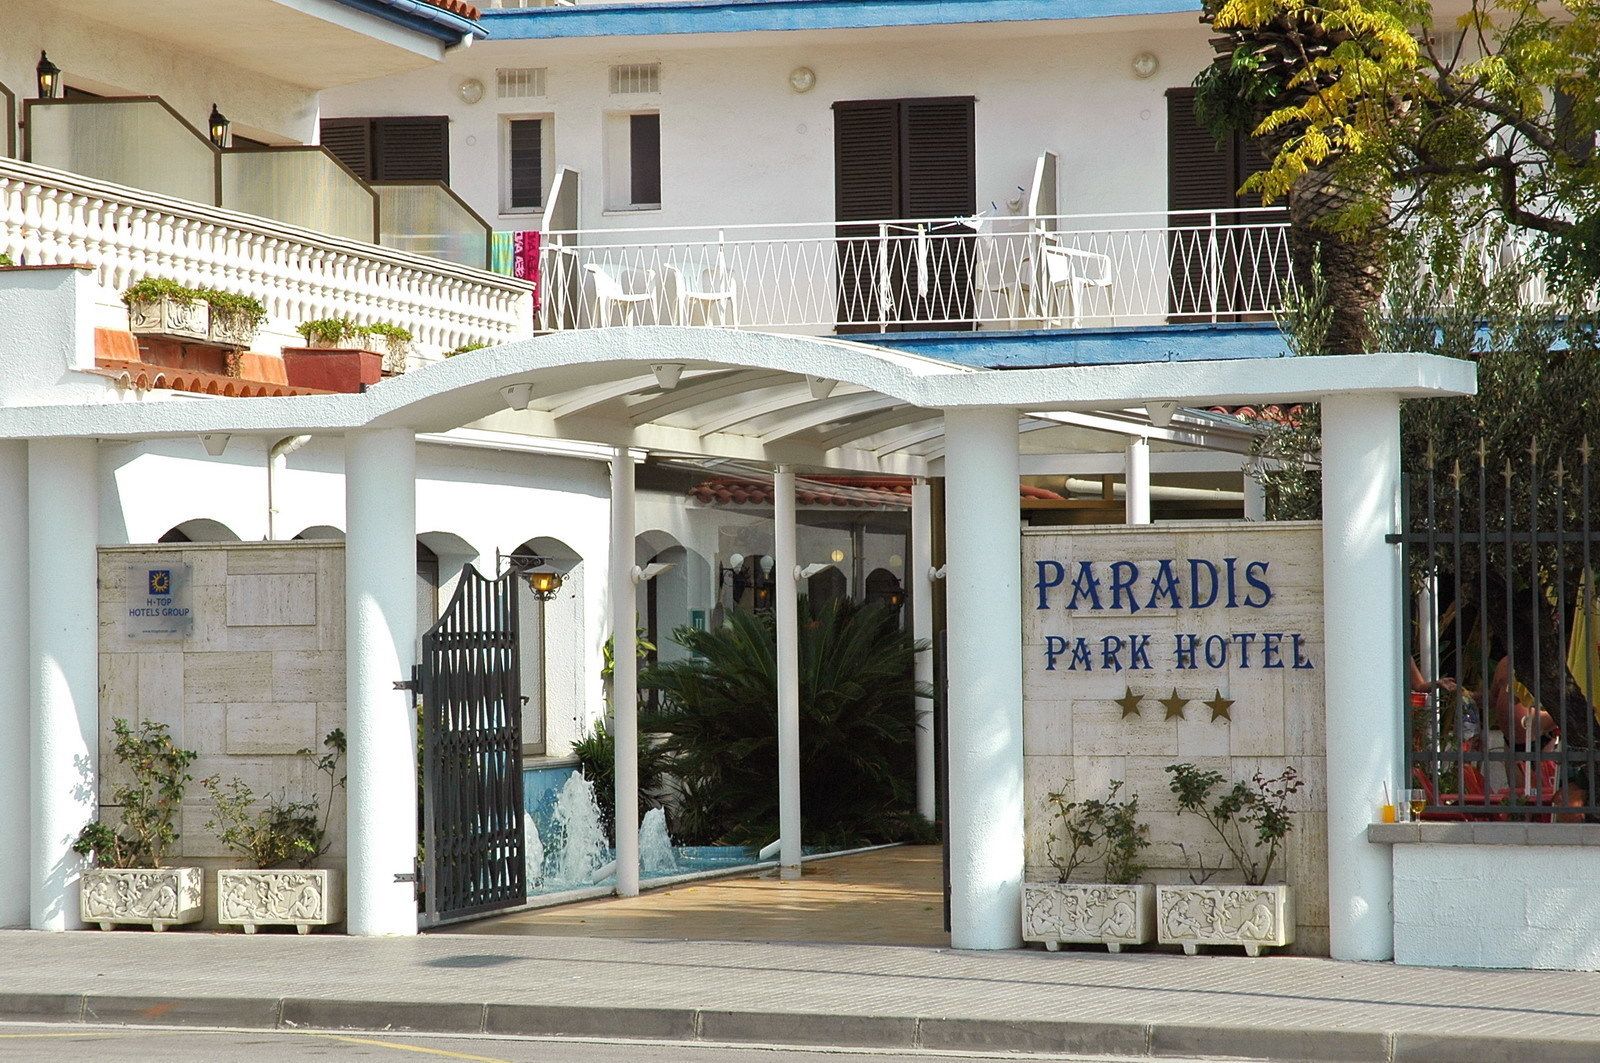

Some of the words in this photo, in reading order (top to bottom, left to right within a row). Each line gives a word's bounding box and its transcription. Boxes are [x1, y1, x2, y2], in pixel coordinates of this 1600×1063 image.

[1034, 558, 1272, 614] PARADIS
[129, 608, 160, 617] HOTELS
[162, 608, 190, 617] GROUP
[1044, 634, 1154, 672] PARK
[1173, 633, 1314, 670] HOTEL
